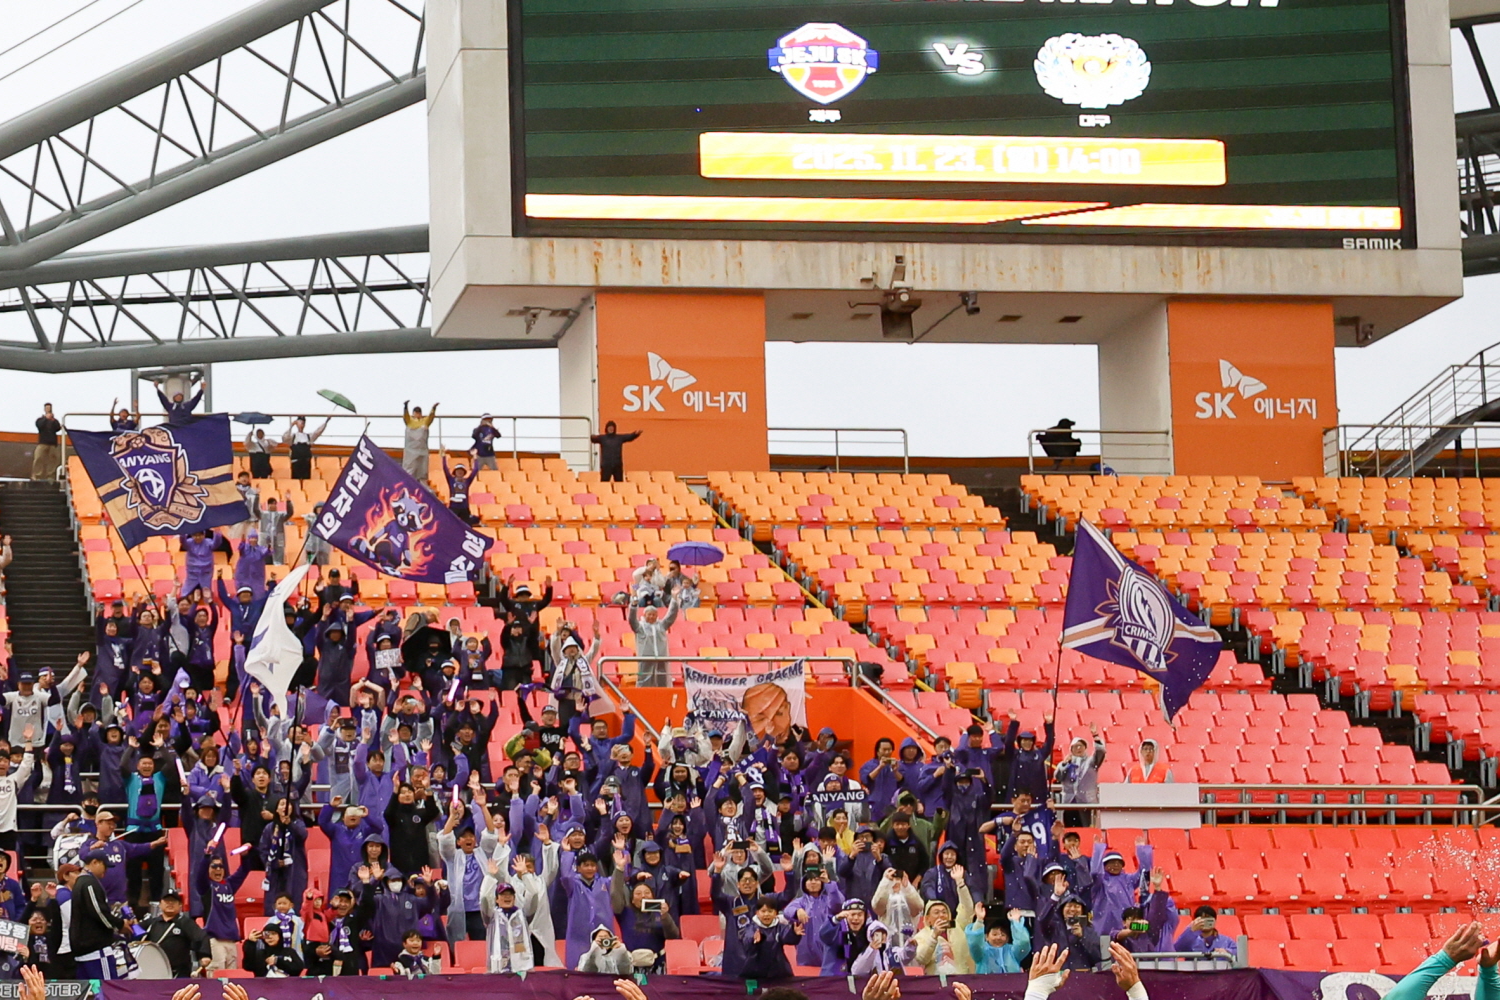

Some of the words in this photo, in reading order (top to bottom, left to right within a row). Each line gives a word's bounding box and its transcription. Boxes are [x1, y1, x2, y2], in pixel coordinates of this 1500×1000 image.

[777, 46, 835, 64] JEJU
[836, 47, 868, 66] SK
[932, 43, 986, 75] VS
[792, 143, 883, 171] 2025.
[933, 145, 985, 173] 23.
[1056, 146, 1143, 175] 14:00
[1343, 239, 1402, 250] SAMIK
[622, 385, 664, 412] SK
[682, 390, 747, 414] 에너지
[1194, 391, 1235, 418] SK
[1253, 397, 1318, 421] 에너지
[119, 453, 172, 468] ANYANG
[685, 667, 747, 687] REMEMBER
[756, 659, 804, 684] GRAEME
[812, 790, 865, 803] ANYANG
